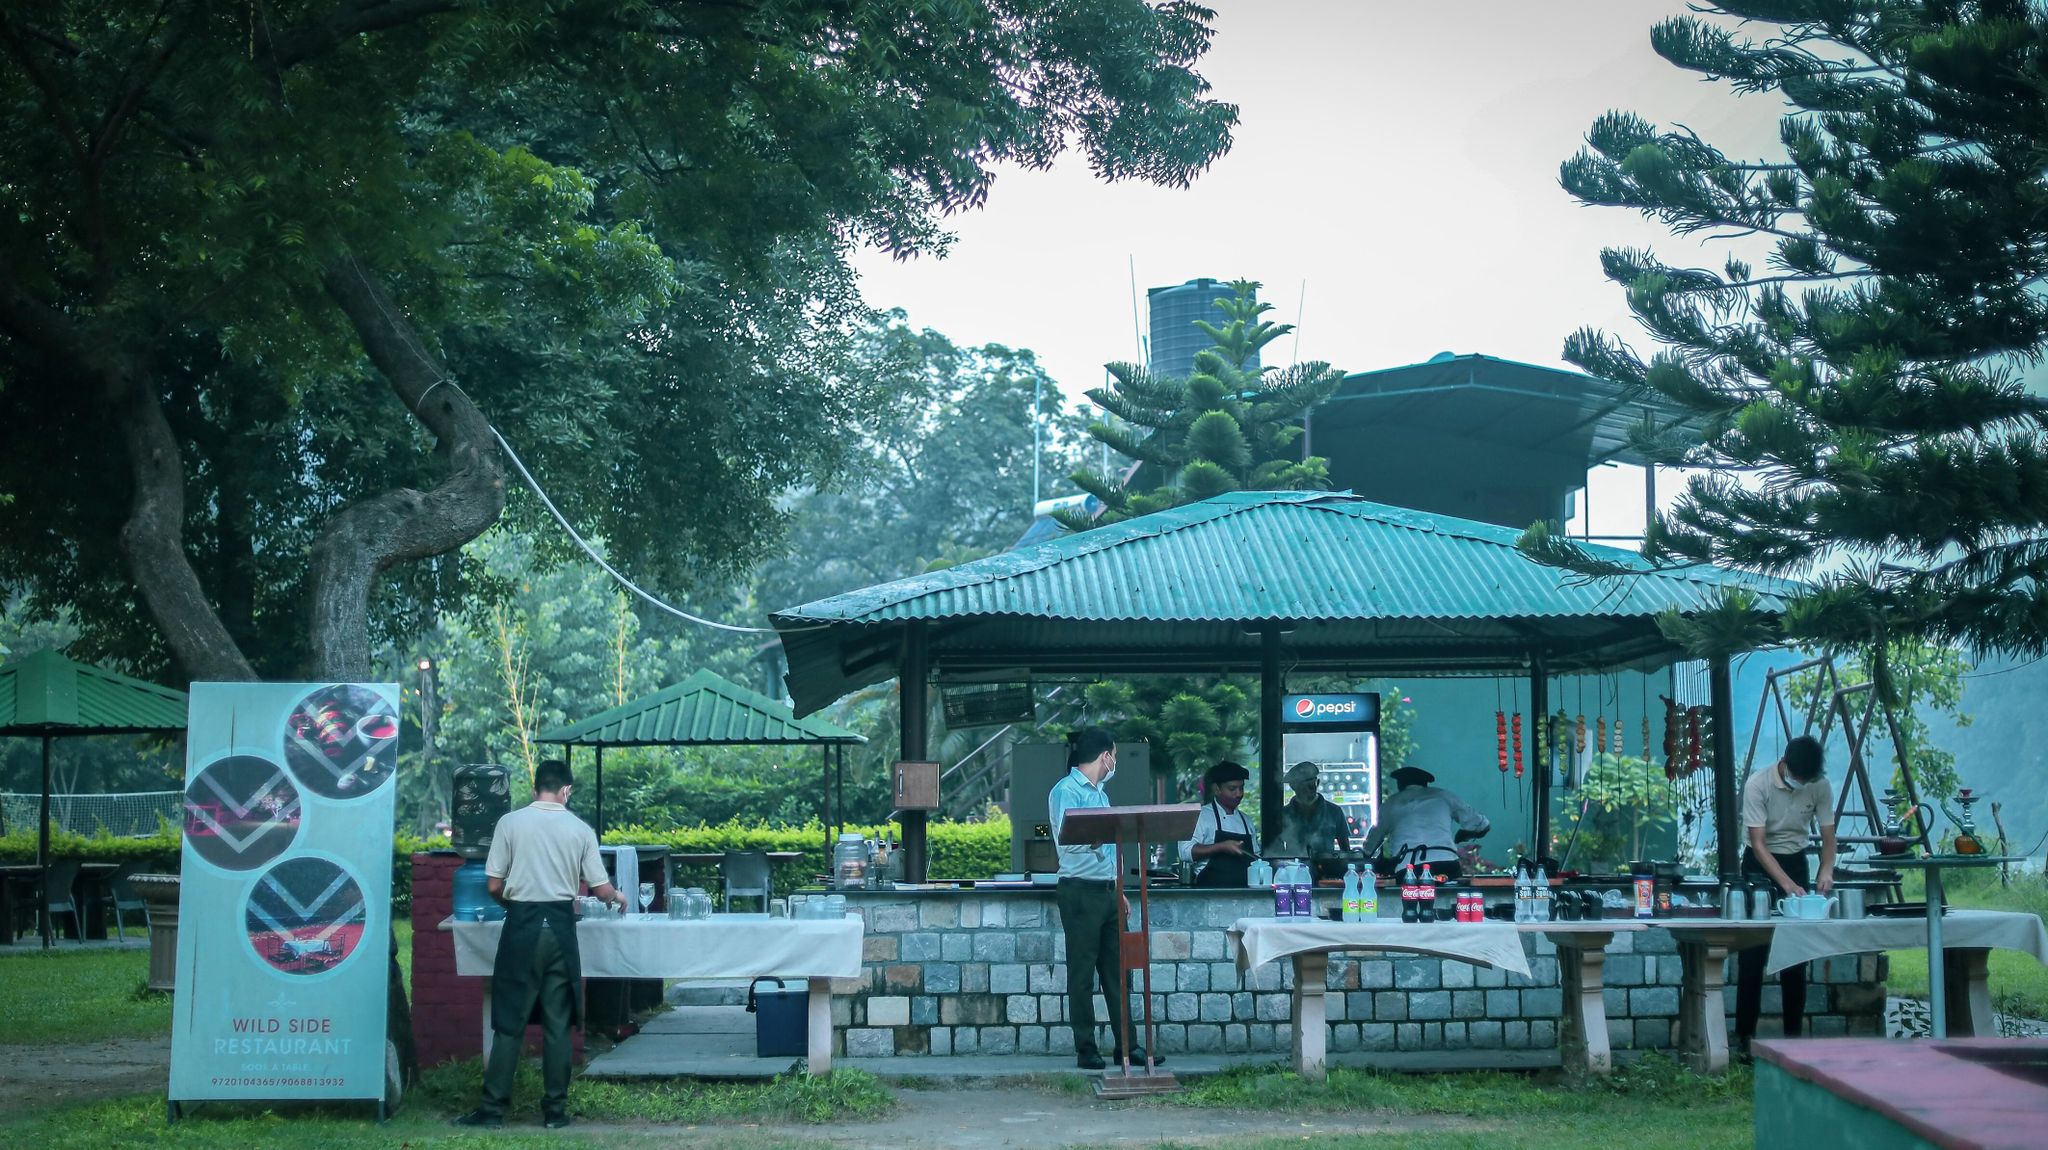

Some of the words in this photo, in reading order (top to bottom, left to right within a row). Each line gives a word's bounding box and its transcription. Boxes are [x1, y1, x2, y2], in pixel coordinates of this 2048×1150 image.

[1317, 701, 1356, 716] pepsi
[232, 1018, 280, 1033] WILD
[288, 1018, 331, 1033] SIDE
[214, 1038, 352, 1055] RESTAURANT
[281, 1063, 308, 1072] TABLE
[211, 1078, 345, 1087] 9720104365/9068813932
